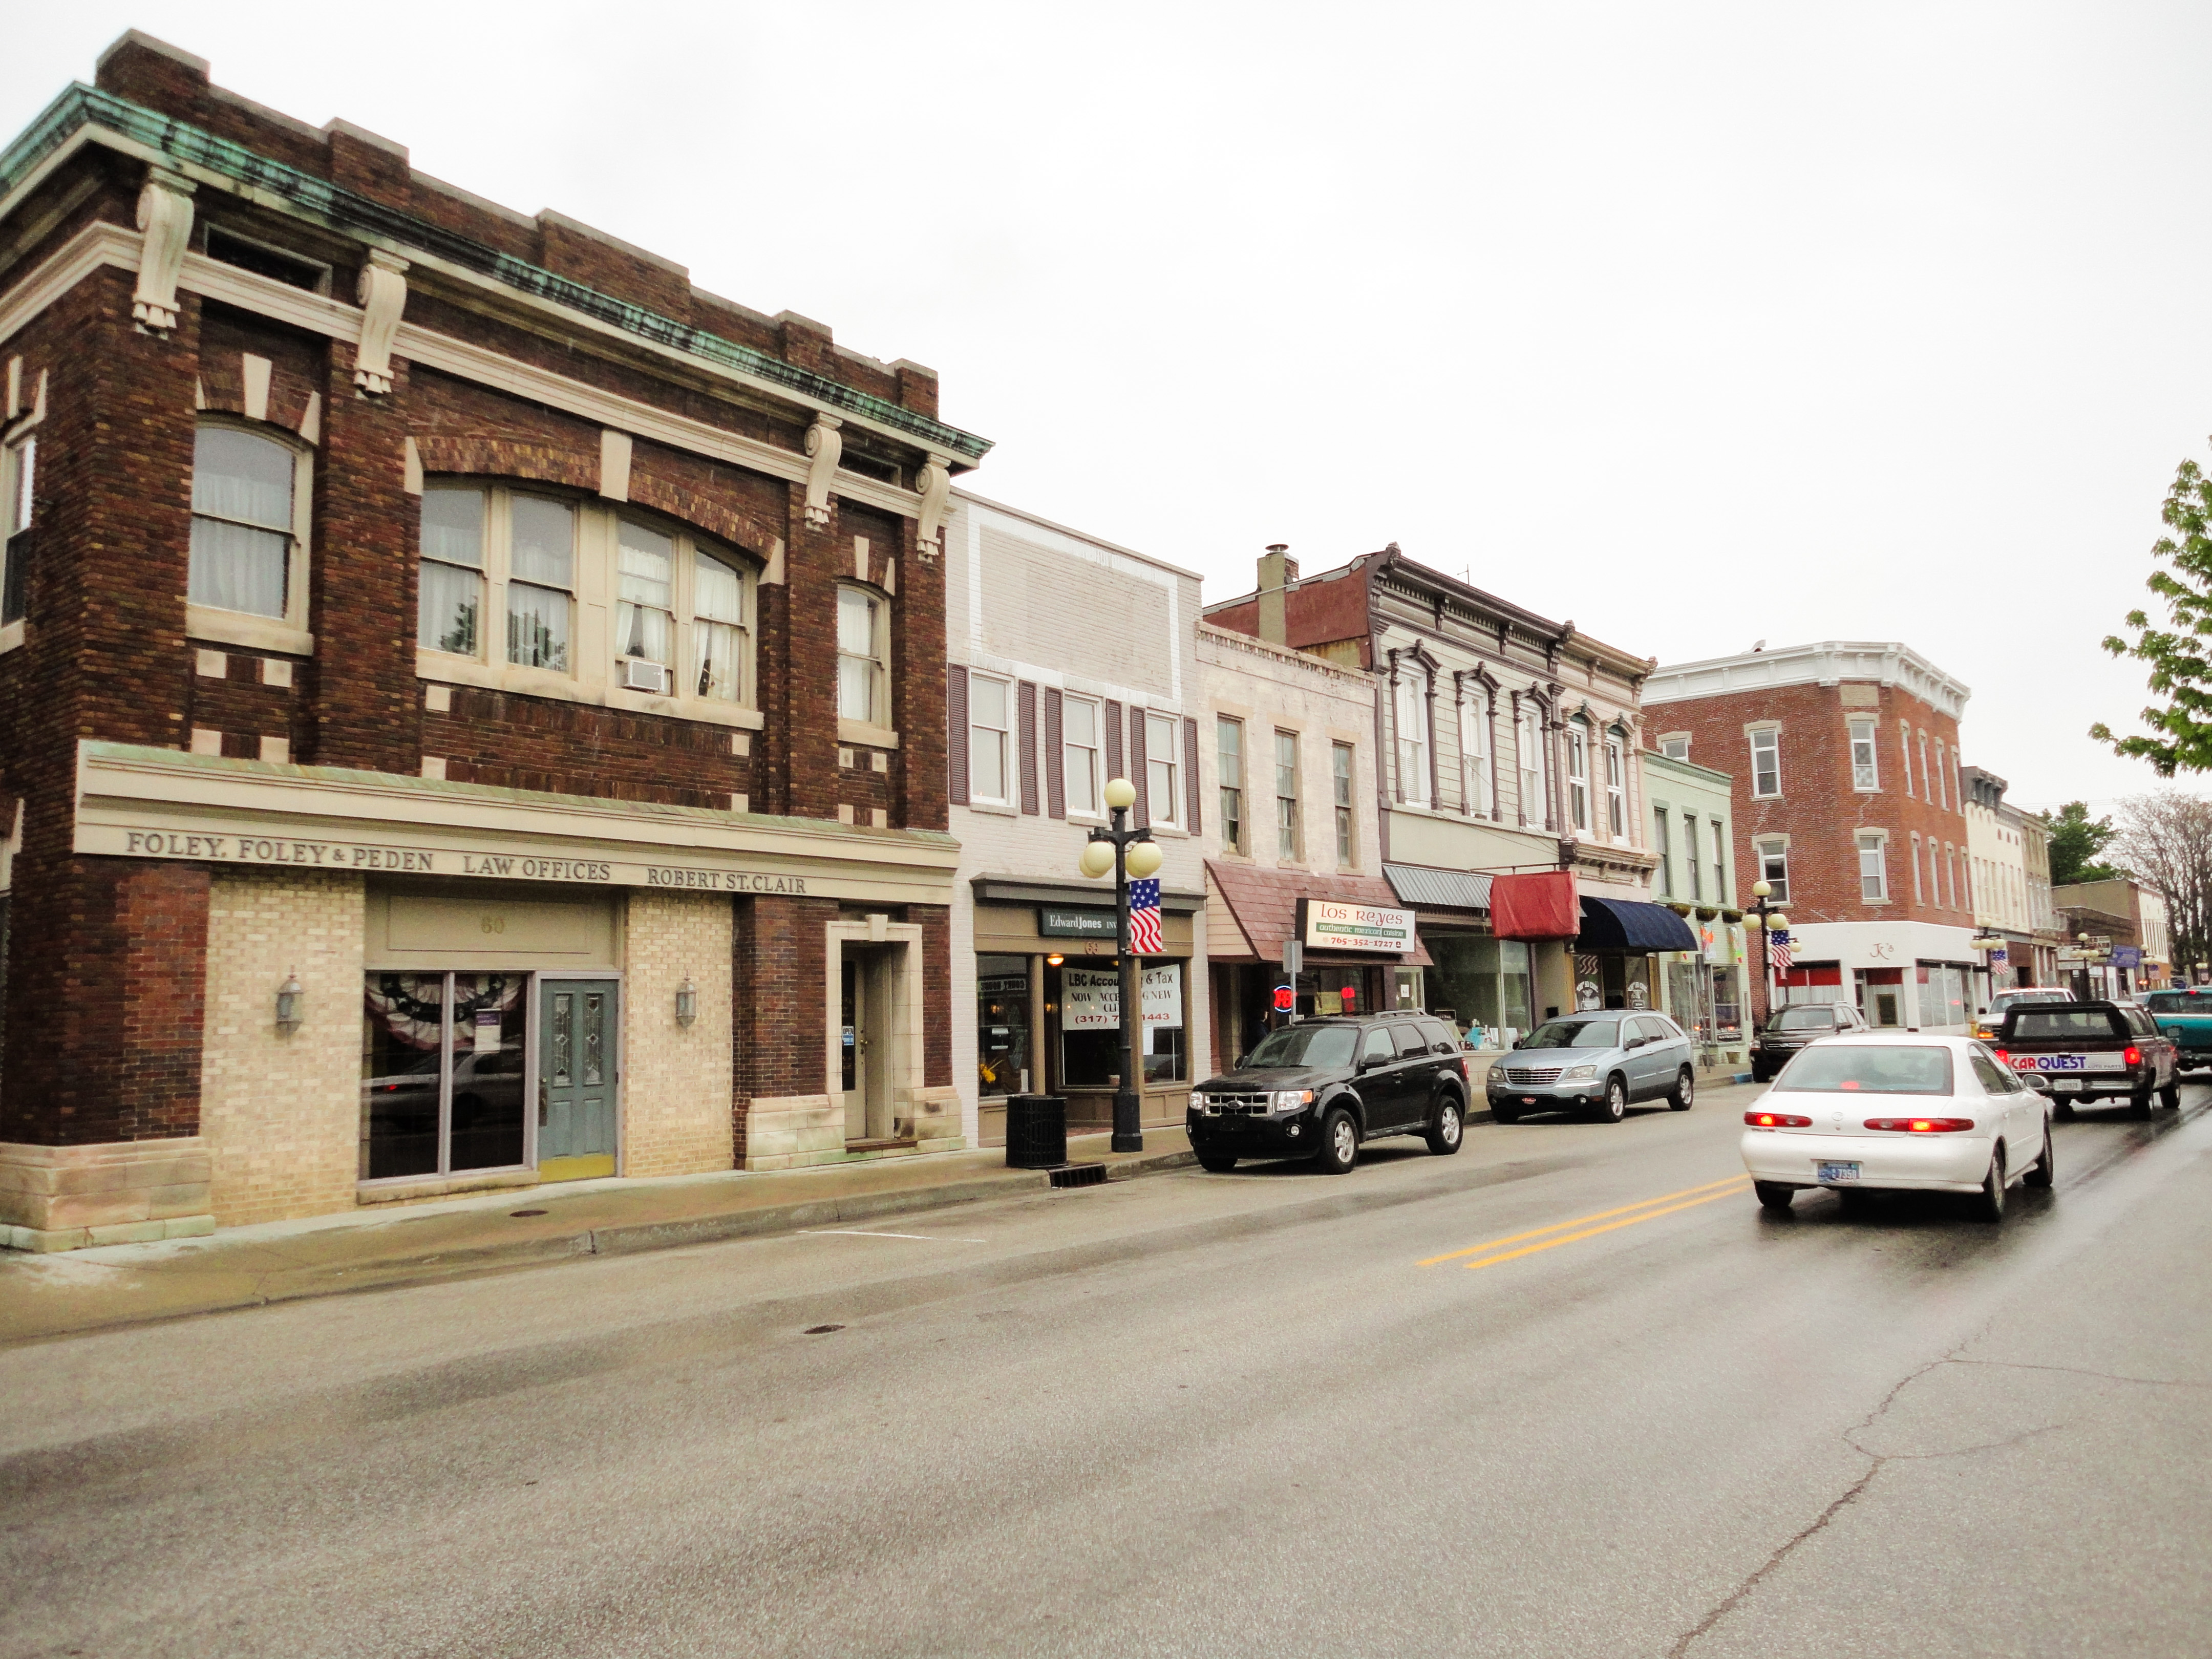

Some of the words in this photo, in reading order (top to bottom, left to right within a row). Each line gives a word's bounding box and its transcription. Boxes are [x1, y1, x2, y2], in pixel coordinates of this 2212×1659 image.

[239, 839, 326, 863] FOLEY
[332, 848, 345, 861] &
[352, 848, 433, 870] PEDEN
[463, 856, 514, 875] LAW
[522, 859, 611, 881] OFFICES
[647, 868, 720, 888] ROBERT
[1320, 924, 1353, 933] authentic
[1331, 937, 1393, 947] 765-352-1727
[1069, 973, 1087, 987] LBC
[1146, 973, 1153, 985] &
[1156, 971, 1173, 985] Tax
[1071, 992, 1092, 1002] NOW
[1152, 990, 1172, 999] NEW
[1075, 1015, 1108, 1024] (317)
